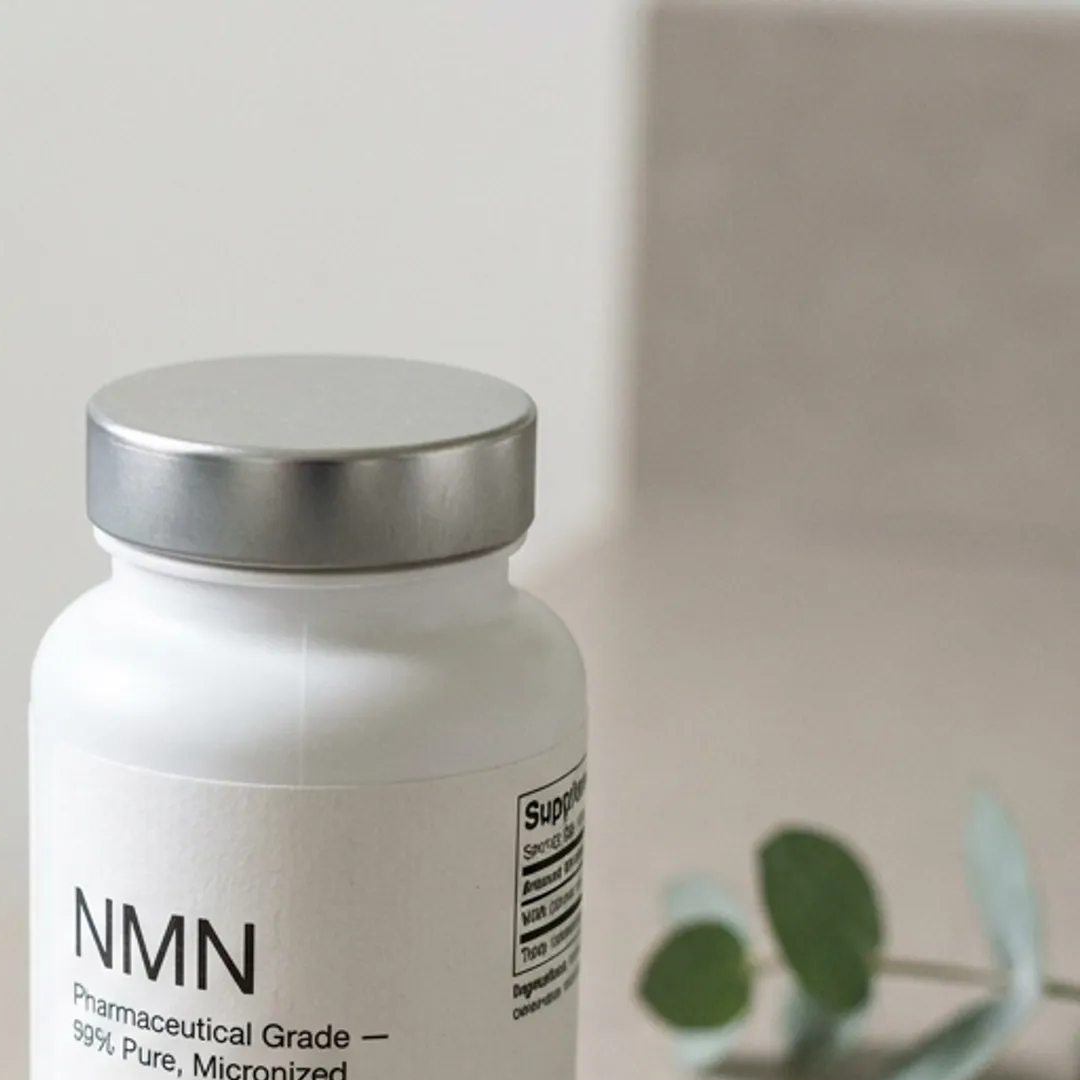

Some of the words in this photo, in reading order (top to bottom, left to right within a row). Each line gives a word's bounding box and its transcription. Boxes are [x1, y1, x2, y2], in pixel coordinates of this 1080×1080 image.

[74, 886, 256, 996] NMN
[122, 1036, 183, 1079] Pure,
[261, 1022, 351, 1050] Grade
